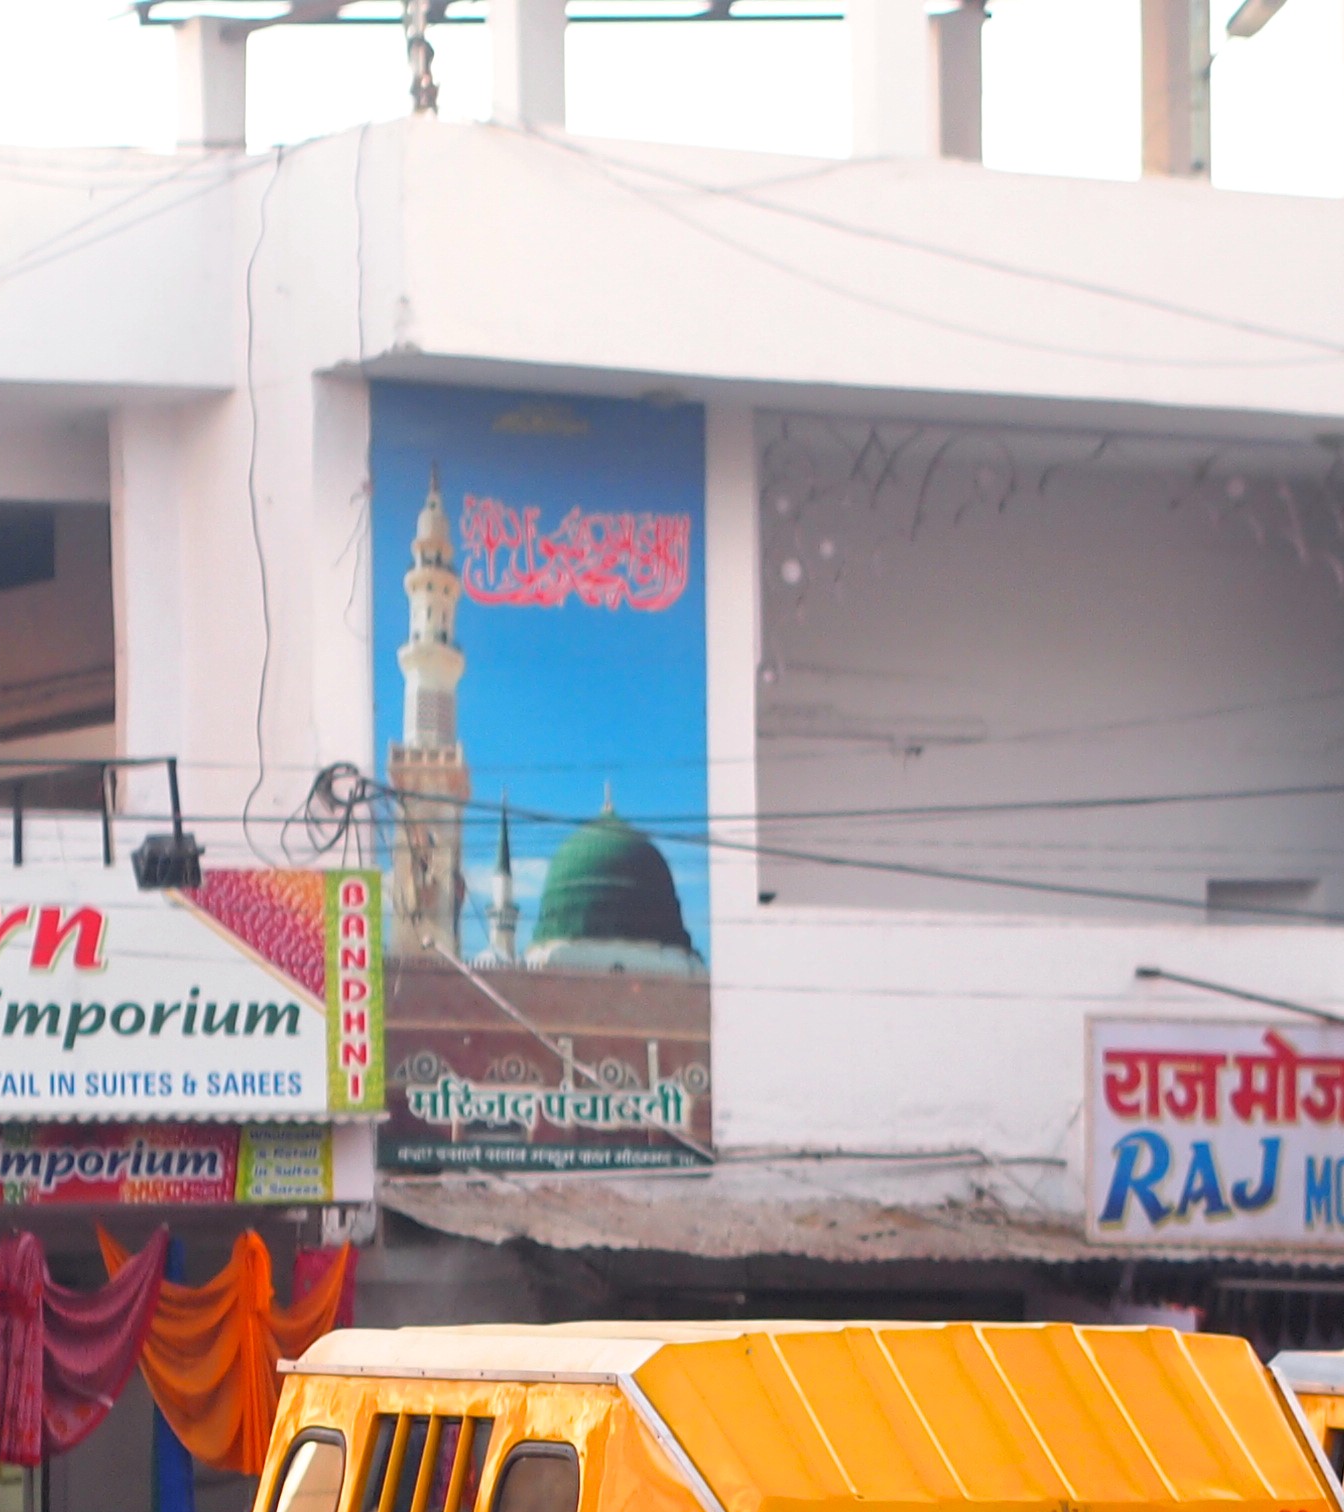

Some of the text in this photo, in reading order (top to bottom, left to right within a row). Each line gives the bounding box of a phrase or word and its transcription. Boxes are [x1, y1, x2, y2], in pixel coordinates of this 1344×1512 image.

[341, 881, 368, 1099] BANDHNI
[49, 1071, 75, 1097] IN
[85, 1071, 173, 1097] SUITES
[181, 1071, 198, 1096] &
[207, 1071, 302, 1097] SAREES
[1105, 1051, 1227, 1122] राज
[1098, 1130, 1282, 1227] RAJ
